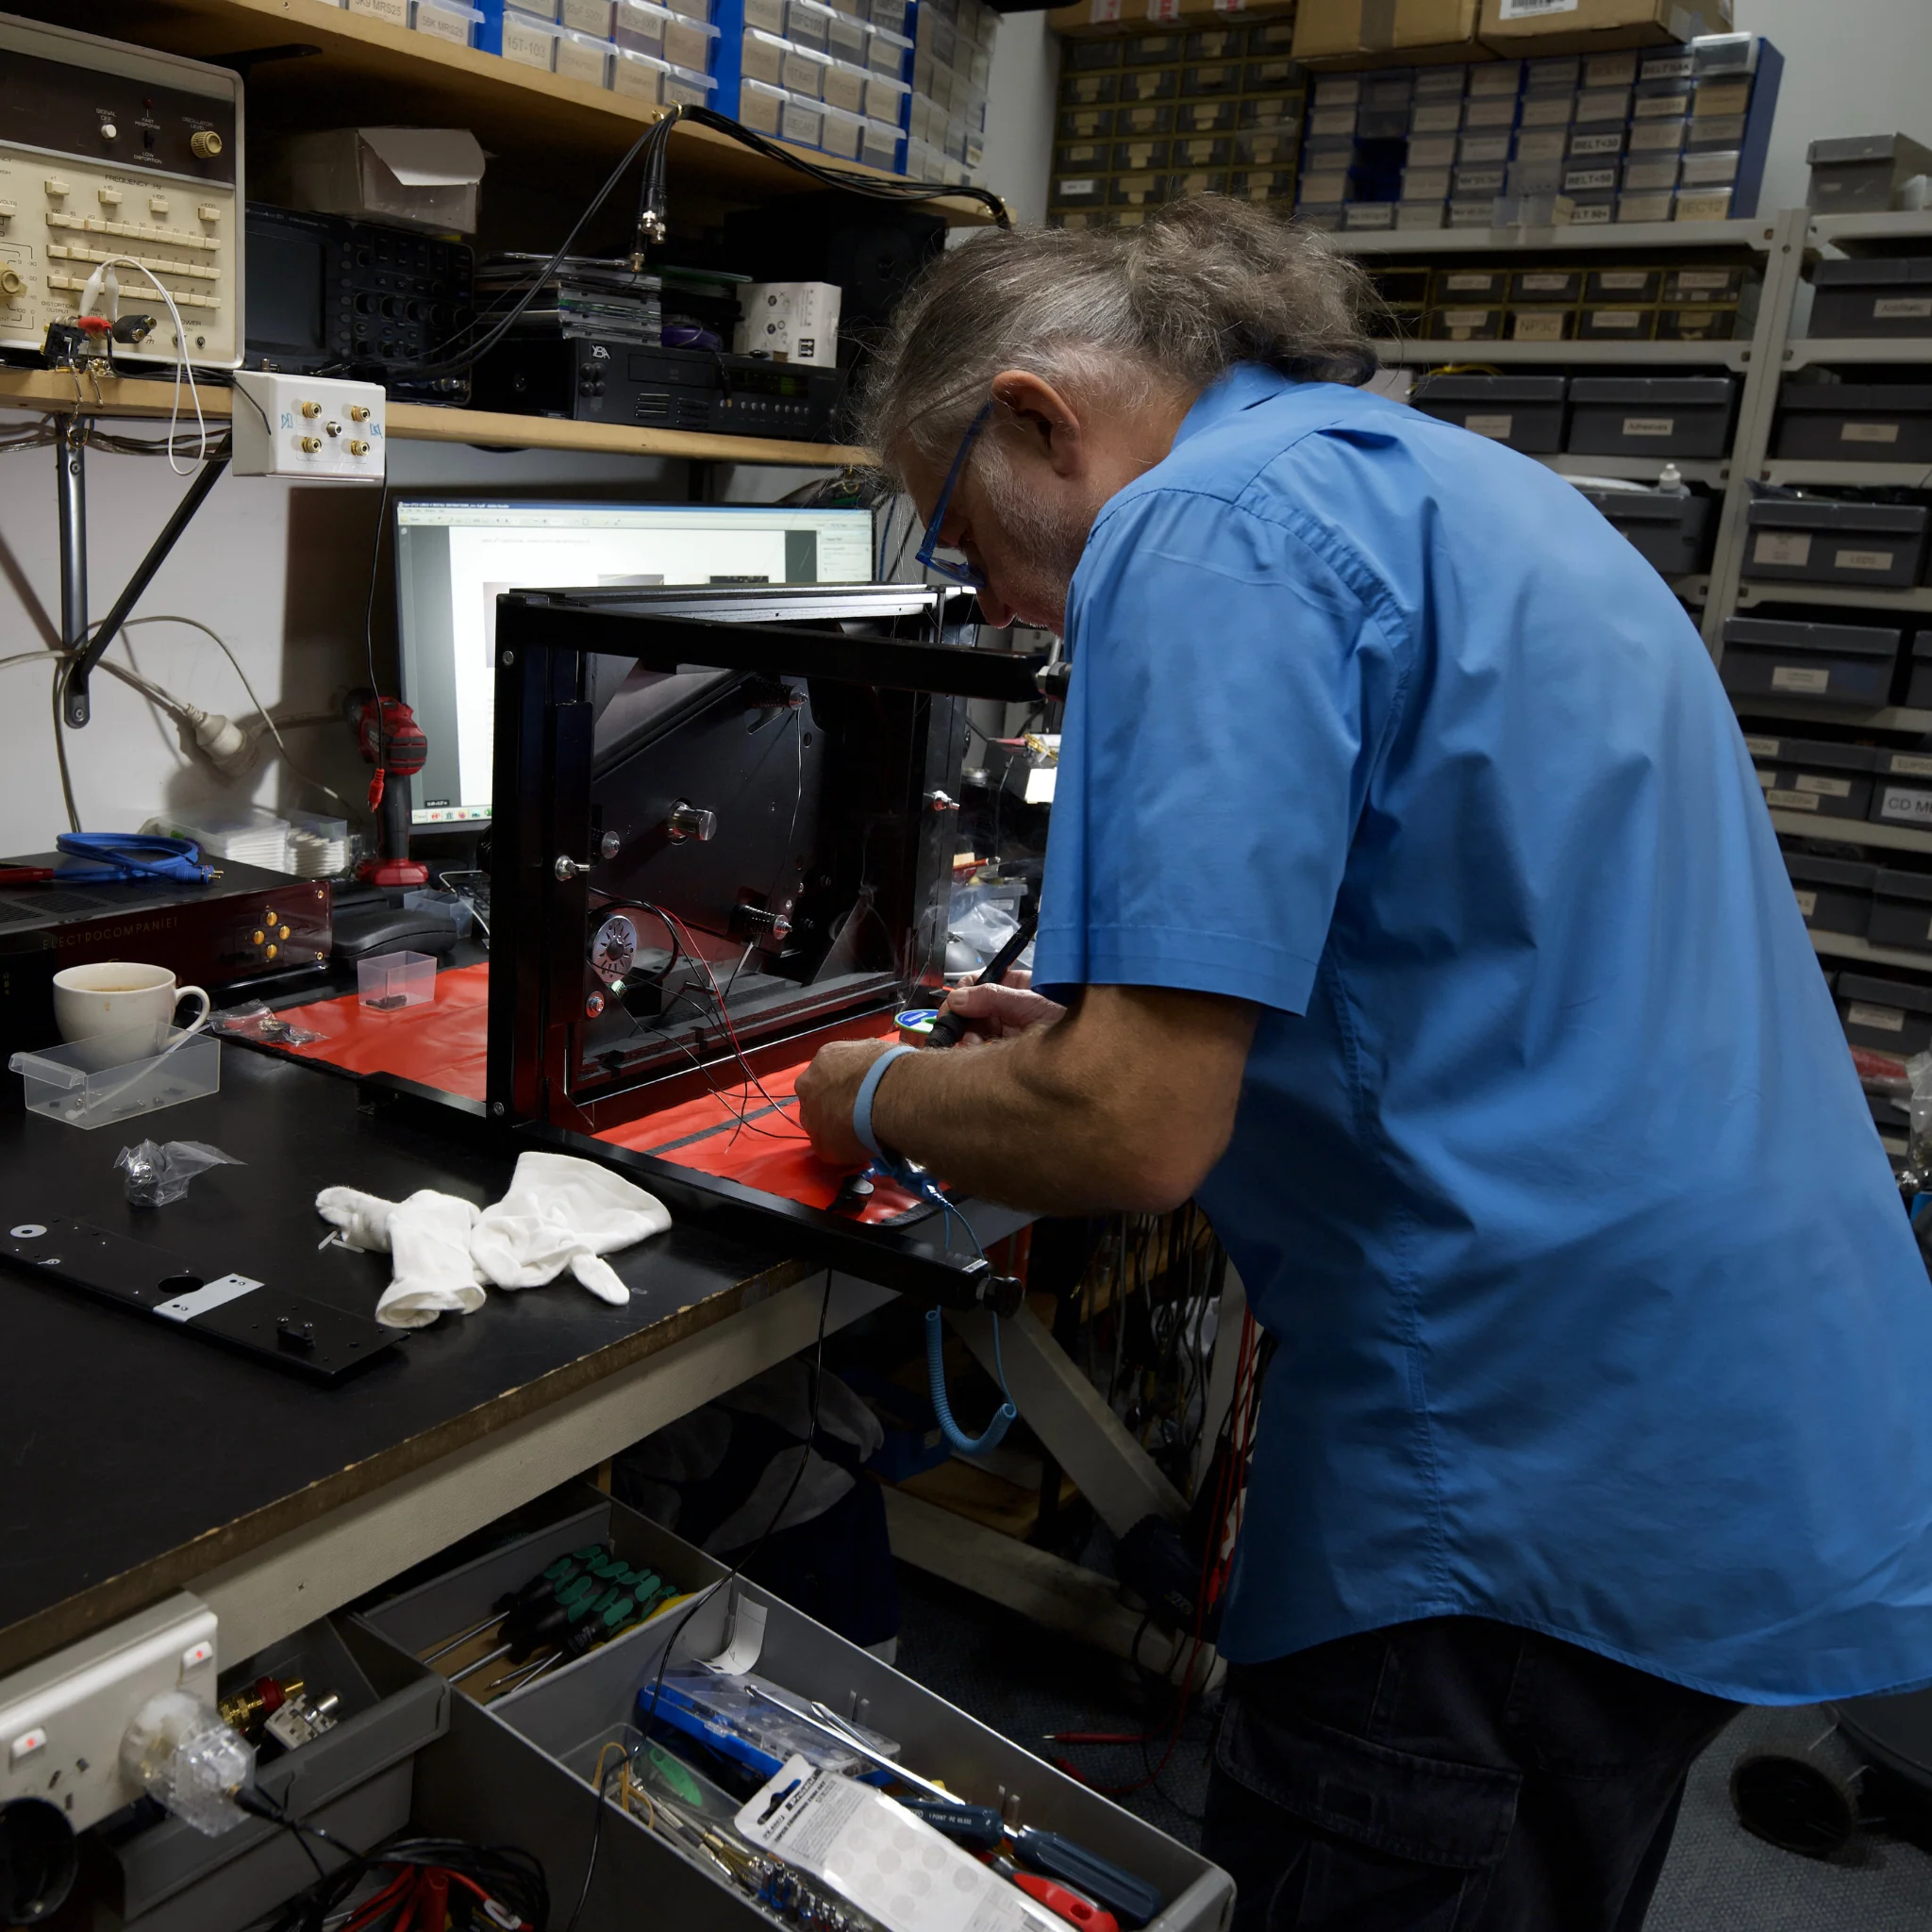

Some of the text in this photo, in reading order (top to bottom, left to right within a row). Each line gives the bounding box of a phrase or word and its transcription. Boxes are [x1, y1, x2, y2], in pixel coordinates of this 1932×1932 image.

[95, 108, 116, 117] SIGNAL
[134, 121, 160, 130] RESPONSE
[182, 116, 214, 127] OSCILLATOR
[134, 154, 162, 164] DISTORTION
[105, 174, 148, 188] FREQUENCY
[41, 300, 75, 309] DISTORTION
[180, 318, 202, 326] OWER
[1888, 796, 1911, 811] CD
[42, 916, 178, 950] ELECTROCOMPANIET
